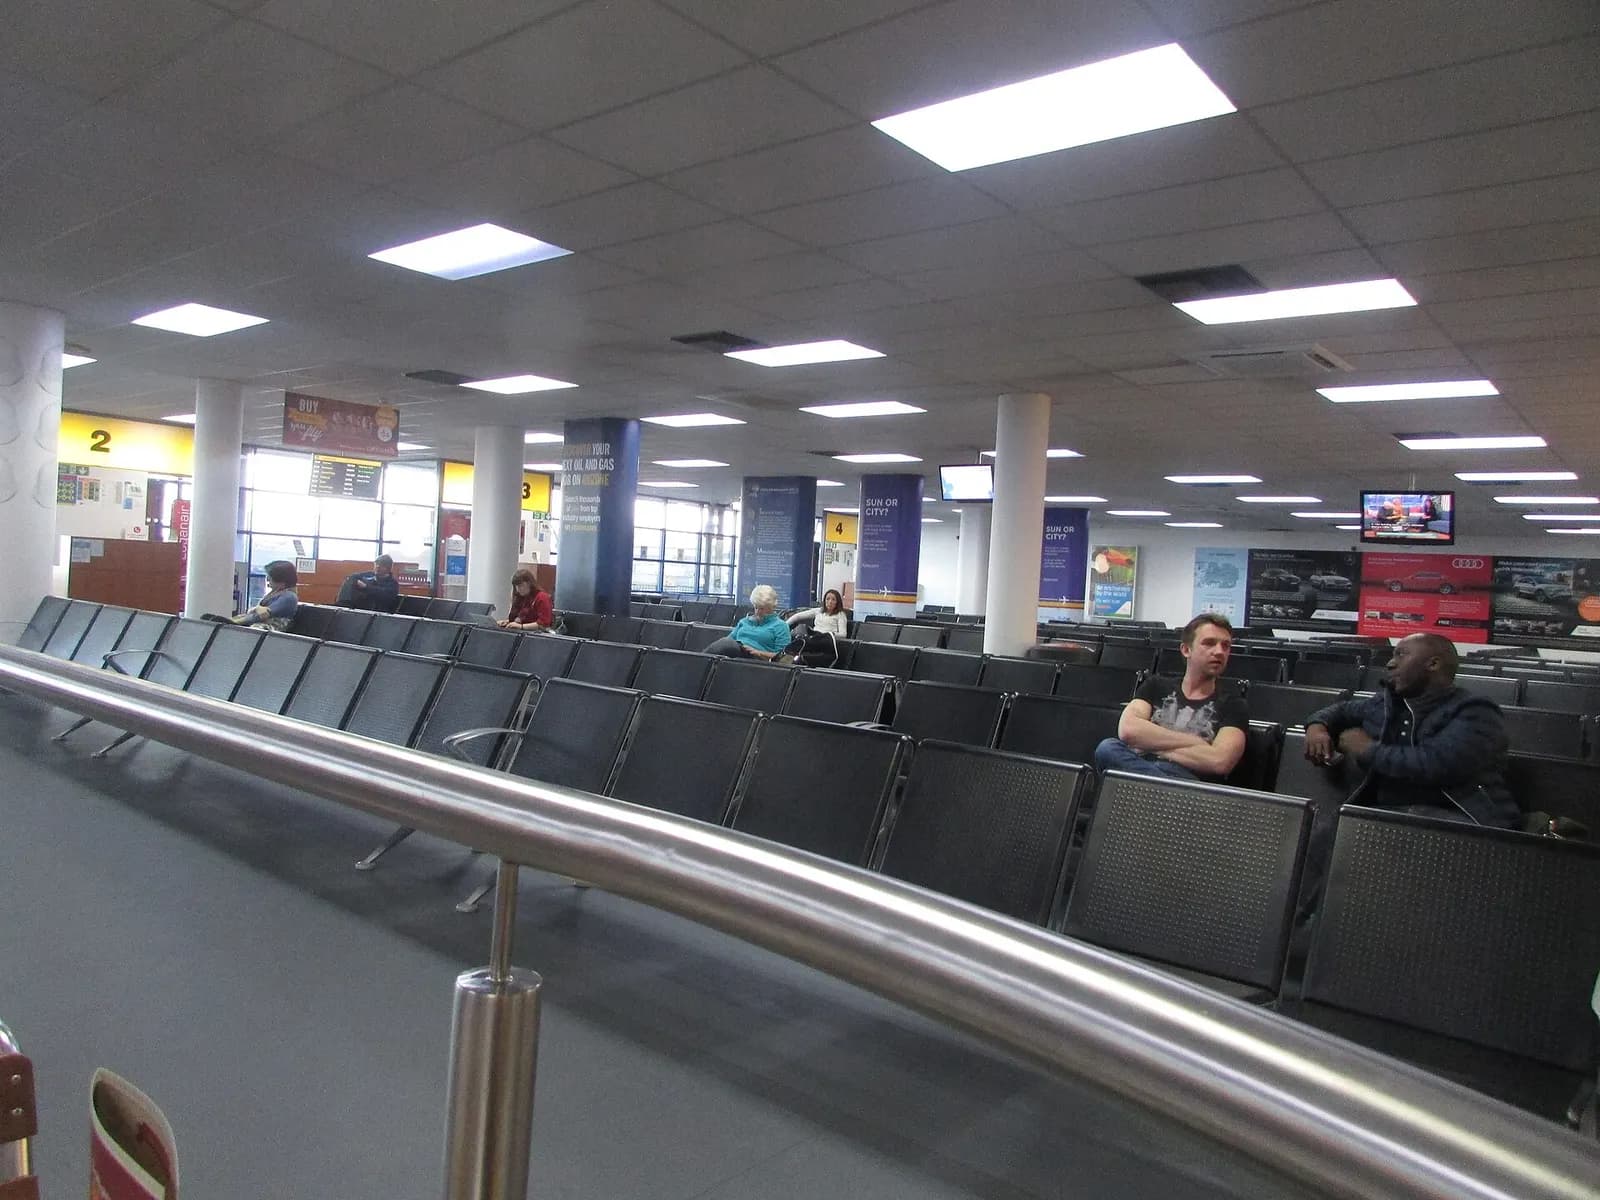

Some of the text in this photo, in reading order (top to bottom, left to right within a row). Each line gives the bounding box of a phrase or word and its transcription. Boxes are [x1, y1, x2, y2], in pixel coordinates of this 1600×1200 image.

[299, 399, 319, 415] BUY
[91, 430, 111, 453] 2
[592, 442, 610, 455] YOUR
[573, 458, 584, 471] OIL
[585, 458, 598, 471] AND
[598, 458, 615, 471] GAS
[522, 482, 531, 499] 3
[866, 498, 898, 507] SUN OR
[865, 507, 888, 516] CITY?
[835, 522, 843, 535] 4
[1046, 525, 1061, 533] SUN
[1045, 533, 1066, 541] CITY?
